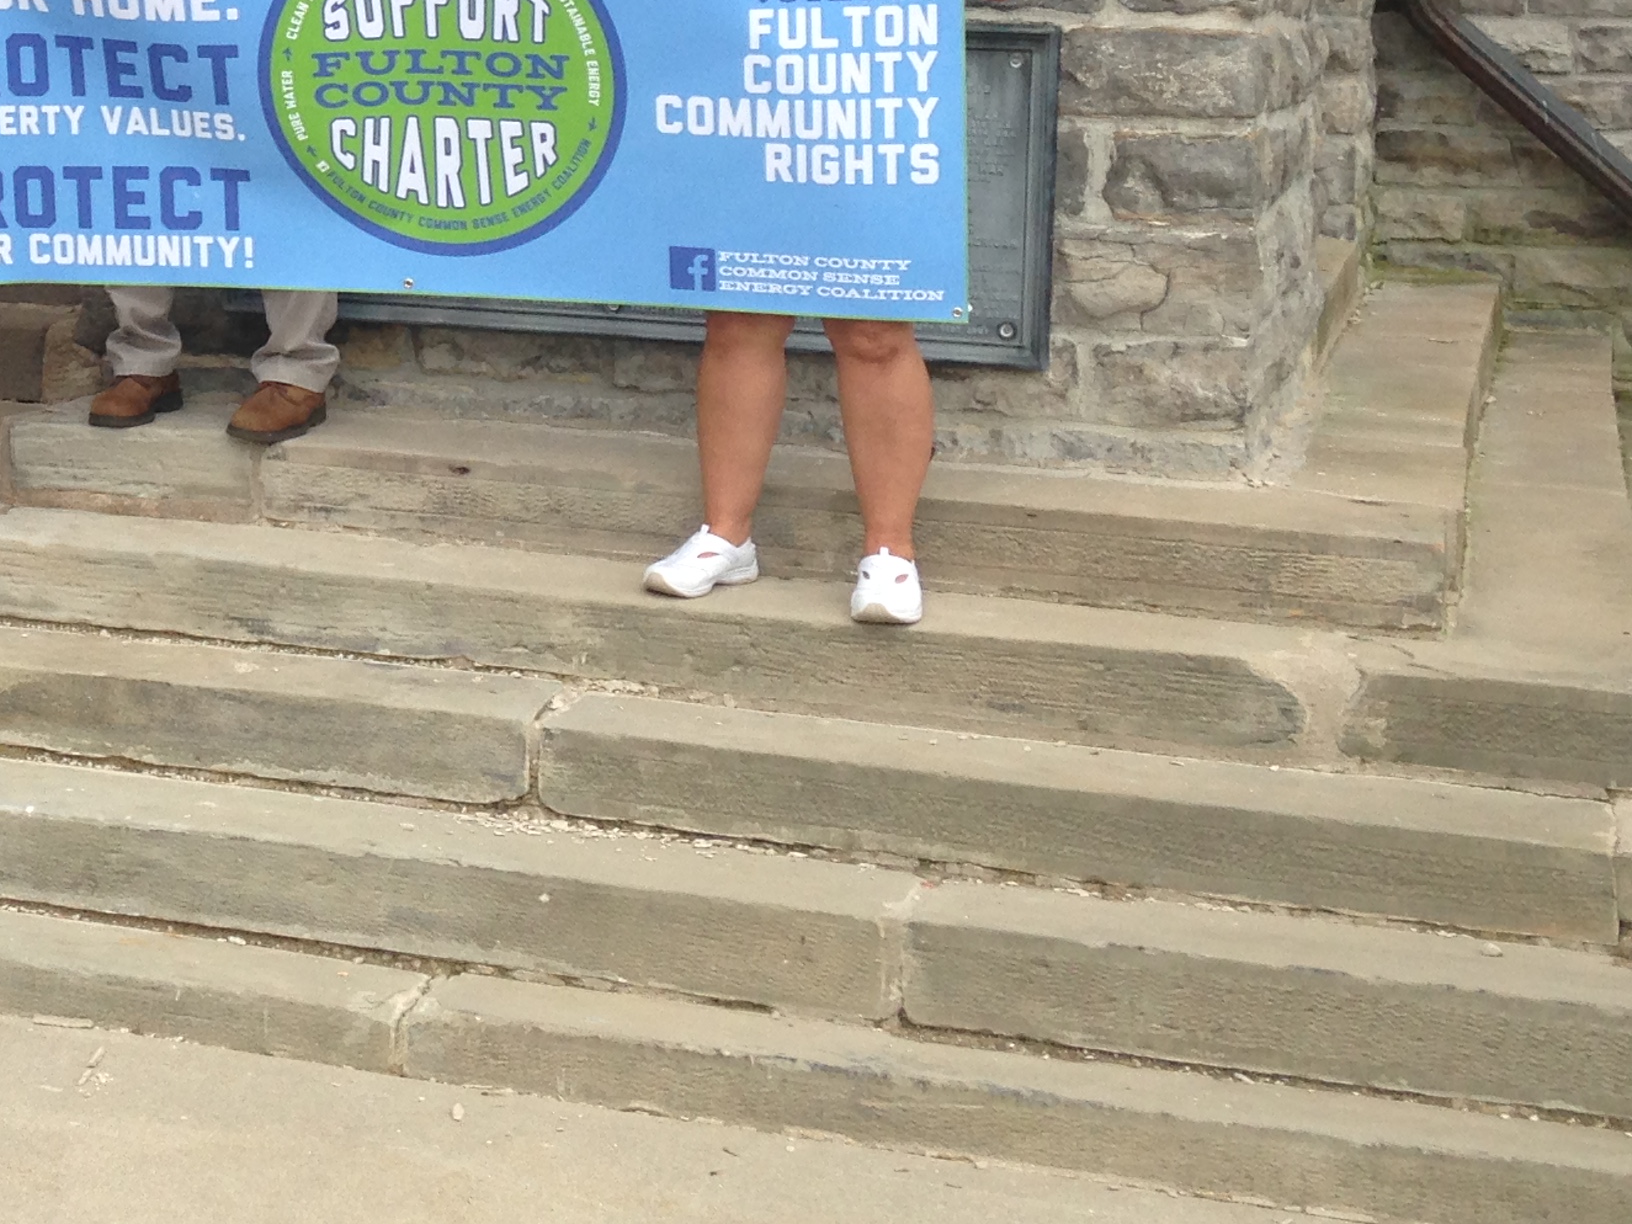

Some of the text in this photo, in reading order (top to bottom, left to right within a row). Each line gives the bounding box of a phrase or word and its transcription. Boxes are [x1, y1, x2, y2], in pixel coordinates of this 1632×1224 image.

[286, 1, 310, 40] CLEAN
[748, 3, 938, 50] FULTON
[311, 49, 570, 79] FULTON
[586, 60, 601, 107] ENERGY
[743, 51, 939, 95] COUNTY
[281, 70, 309, 142] PURE WATER
[313, 80, 568, 111] COUNTY
[101, 106, 246, 142] VALUES.
[655, 95, 940, 140] COMMUNITY
[330, 114, 559, 208] CHARTER
[764, 143, 940, 185] RIGHTS
[327, 138, 591, 231] FULTON COUNTY COMMON SENSE ENERGY COALITION
[28, 232, 255, 269] COMMUNITY!
[718, 251, 912, 271] FULTON COUNTY
[718, 266, 901, 286] COMMON SENSE
[718, 280, 946, 302] ENERGY COALITION
